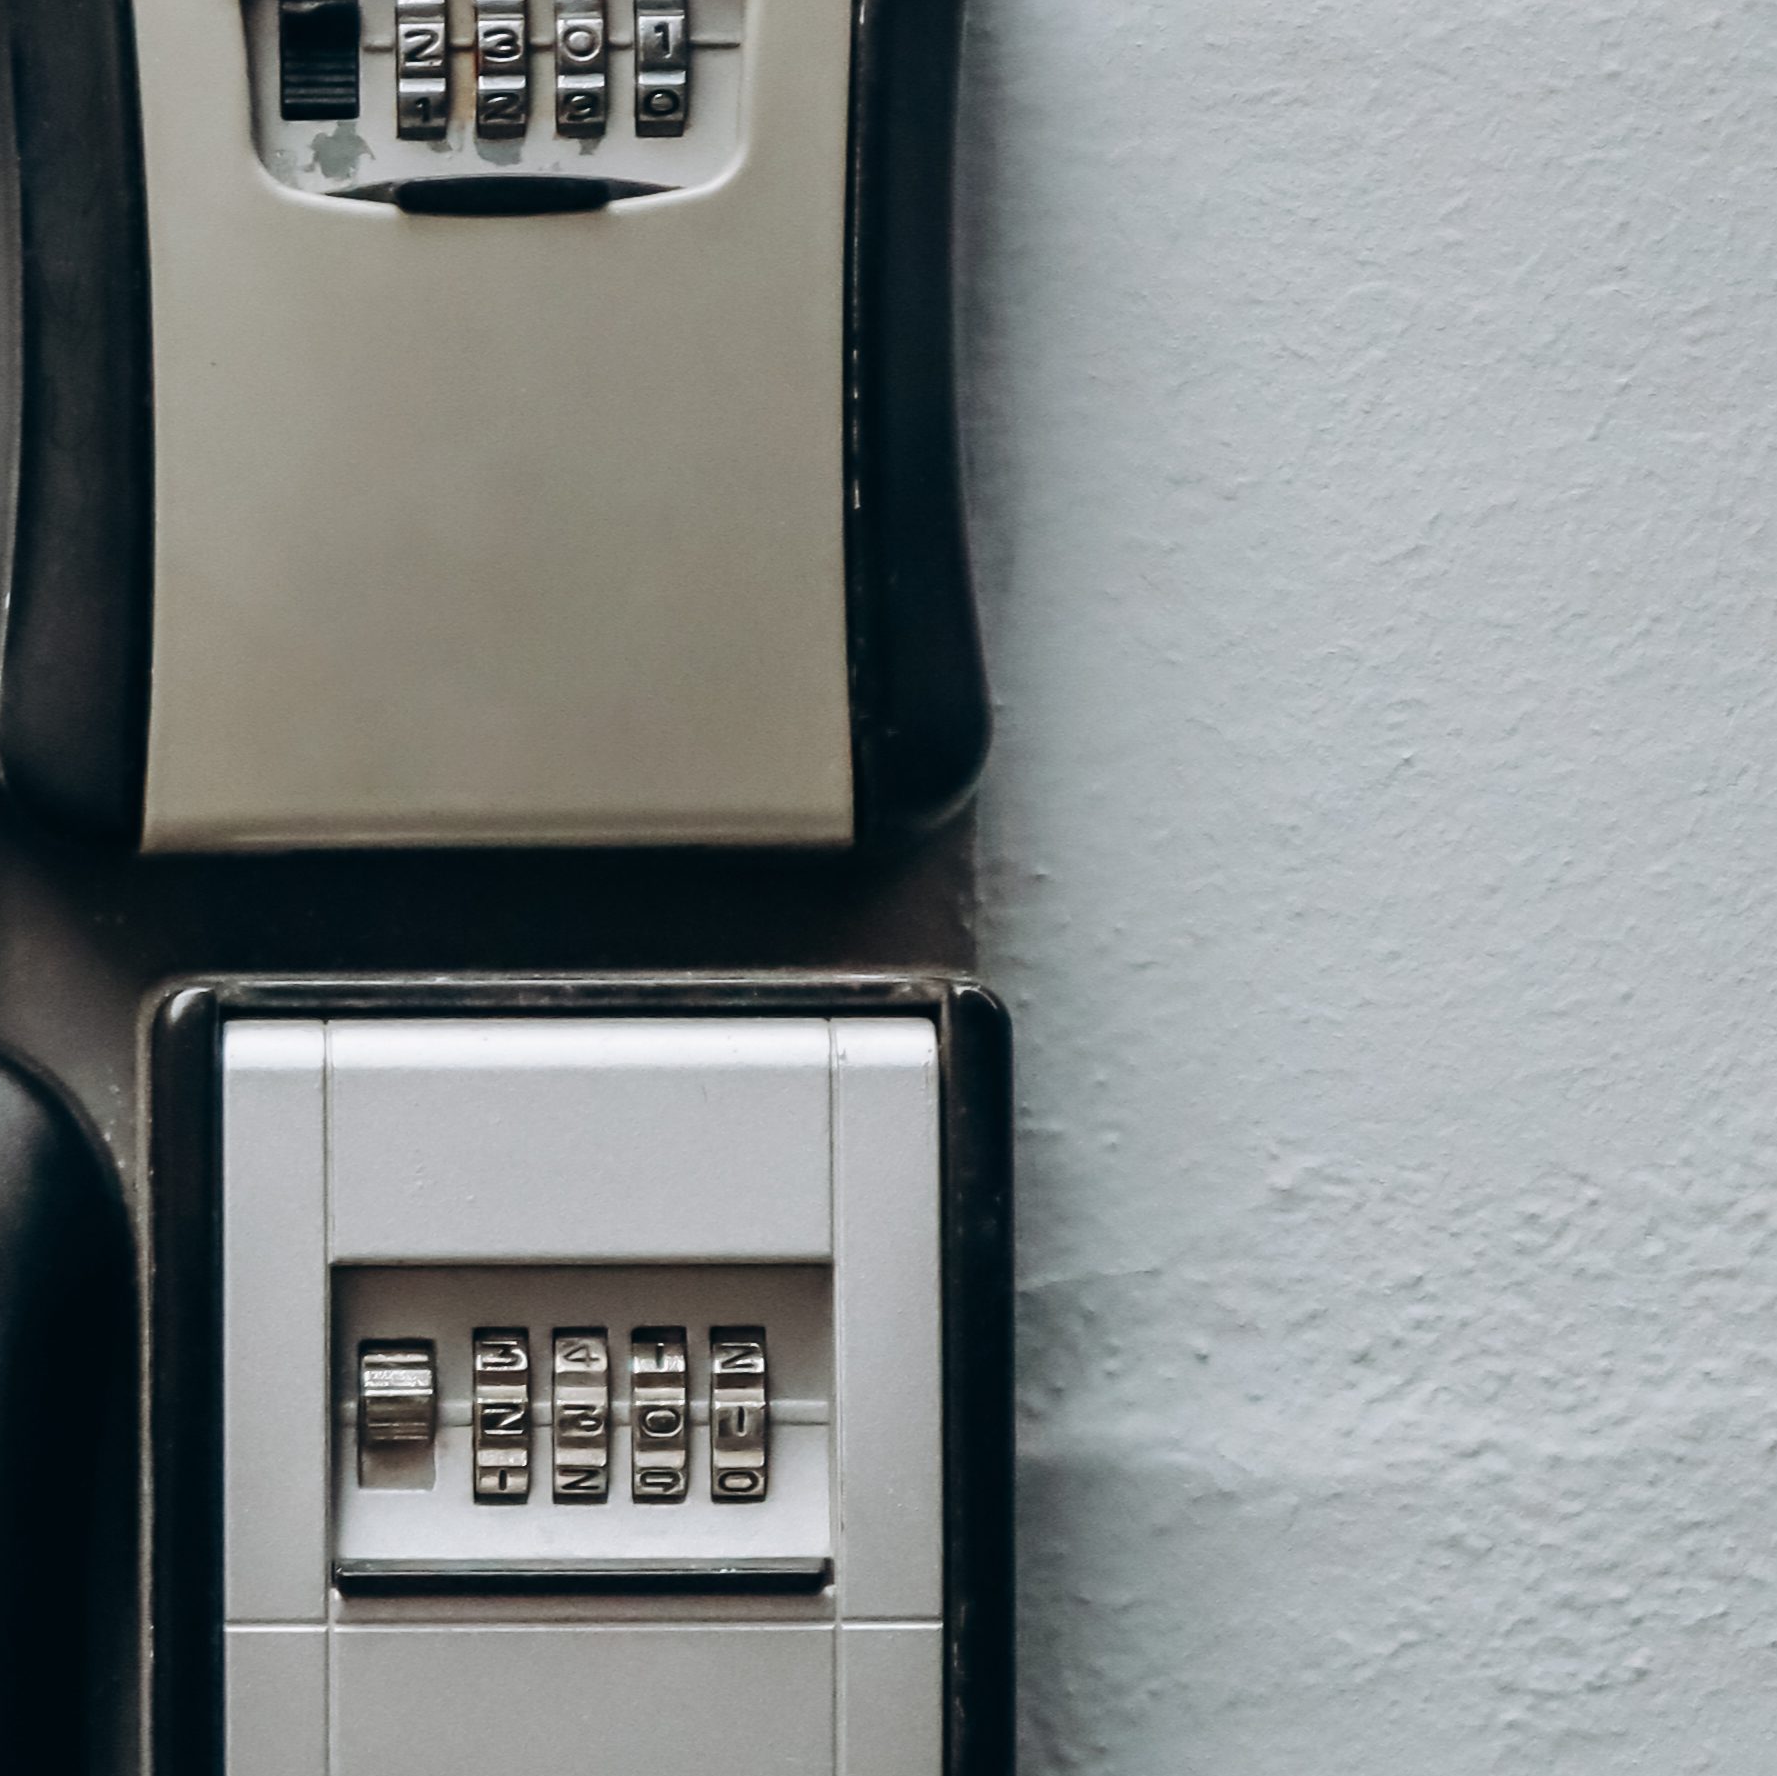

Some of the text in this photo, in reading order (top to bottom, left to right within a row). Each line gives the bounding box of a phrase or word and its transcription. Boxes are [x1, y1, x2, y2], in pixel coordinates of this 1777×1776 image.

[404, 21, 672, 67] 2 3 0 1
[415, 97, 431, 122] 1
[482, 92, 521, 122] 2
[642, 88, 680, 116] 0
[480, 1341, 526, 1371] 3
[563, 1343, 601, 1368] 4
[719, 1342, 762, 1369] 2
[480, 1402, 525, 1435] 2
[561, 1404, 605, 1437] 3
[640, 1405, 684, 1438] 0
[558, 1467, 602, 1491] 2
[718, 1469, 761, 1493] 0
